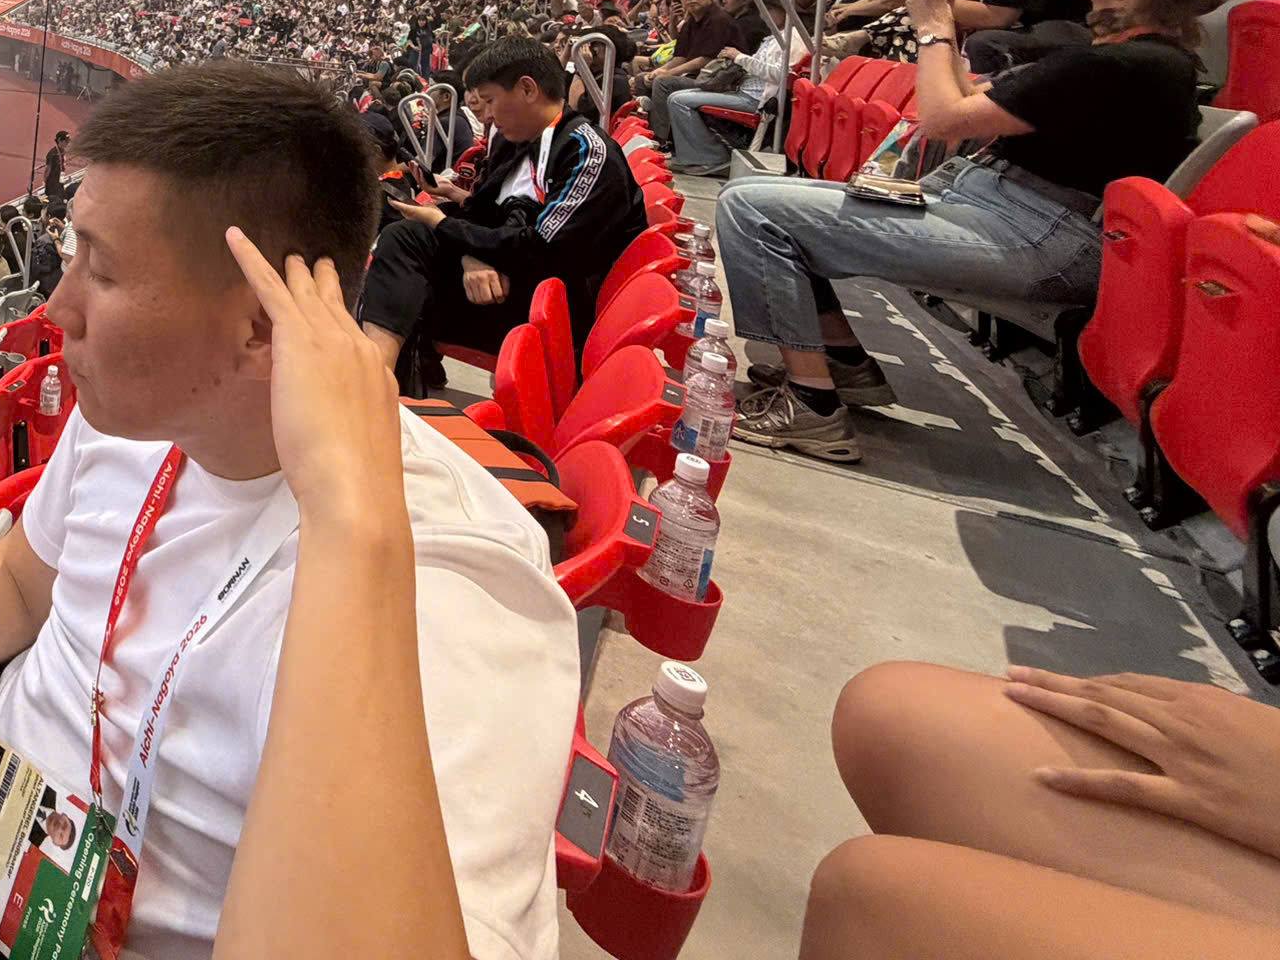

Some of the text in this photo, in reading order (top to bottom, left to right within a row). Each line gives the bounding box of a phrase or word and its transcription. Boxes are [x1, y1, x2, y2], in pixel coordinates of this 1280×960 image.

[114, 461, 173, 606] Aichi-Nagoya 2026
[632, 514, 650, 527] 5
[217, 557, 250, 601] BORNAN
[139, 615, 207, 768] Aichi-Nagoya 2026
[574, 788, 600, 809] 4
[12, 892, 24, 909] E
[51, 832, 95, 960] Opening Ceremony Pa
